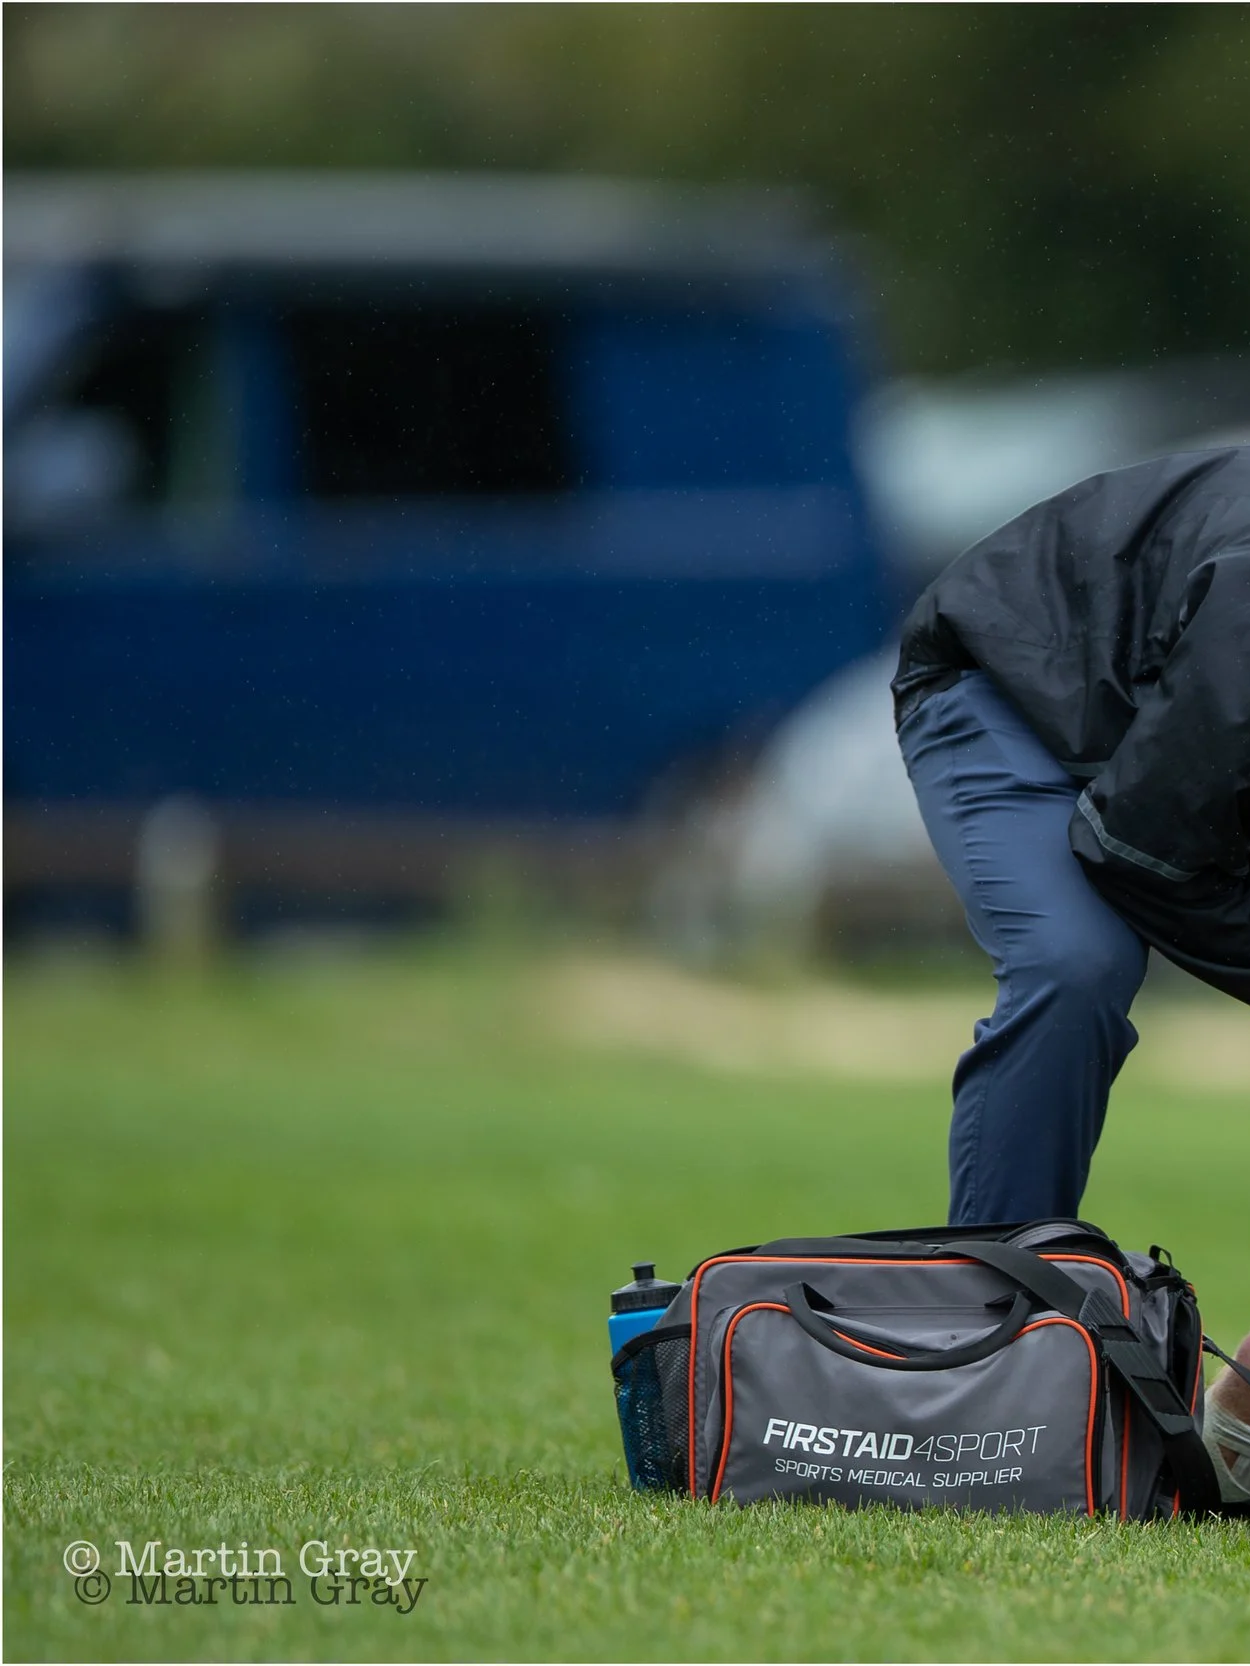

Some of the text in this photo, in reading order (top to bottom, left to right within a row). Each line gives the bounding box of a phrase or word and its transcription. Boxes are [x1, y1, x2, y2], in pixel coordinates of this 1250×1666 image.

[762, 1417, 1048, 1462] FIRSTAID4SPORT
[774, 1458, 1023, 1488] SPORTS MEDICAL SUPPLIER
